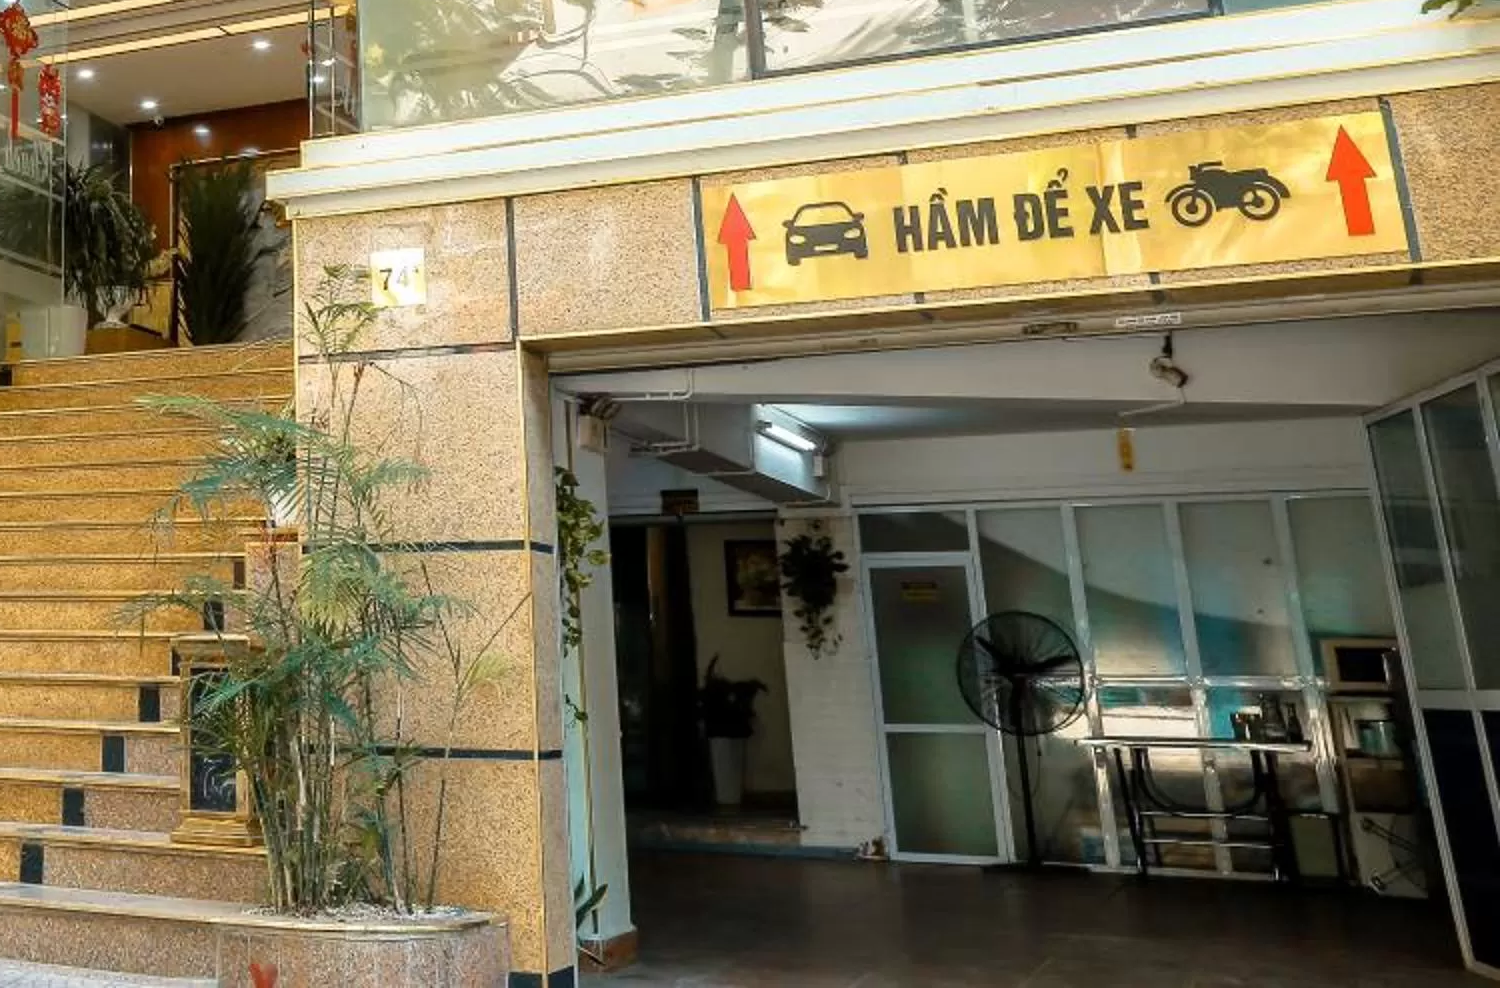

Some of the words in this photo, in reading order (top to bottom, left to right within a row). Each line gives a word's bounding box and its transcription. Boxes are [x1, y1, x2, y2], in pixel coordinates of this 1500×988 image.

[892, 187, 1000, 253] HẦM
[1012, 167, 1074, 241] ĐỂ
[1085, 180, 1150, 236] XE
